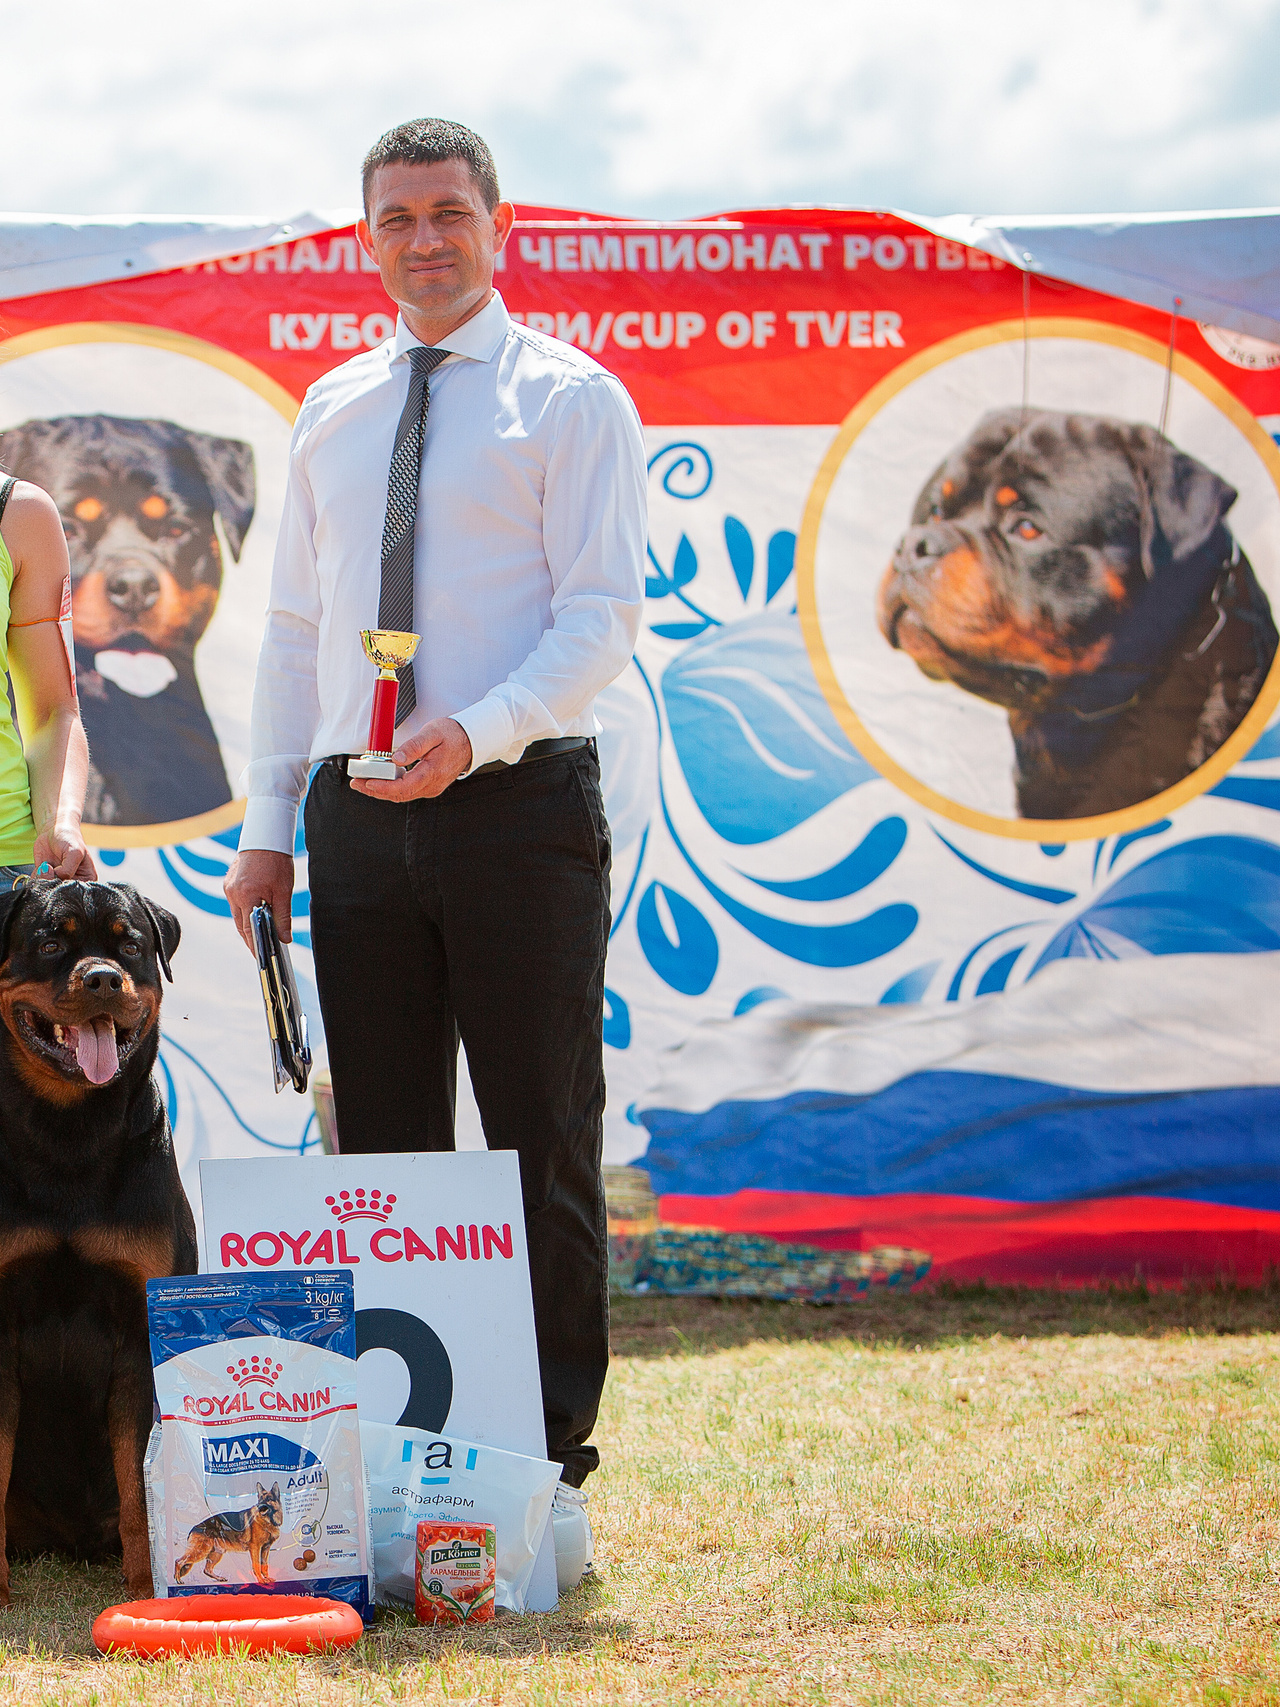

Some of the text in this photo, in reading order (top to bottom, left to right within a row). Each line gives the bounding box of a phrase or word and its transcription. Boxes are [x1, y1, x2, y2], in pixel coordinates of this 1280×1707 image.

[519, 234, 830, 272] ЧЕМПИОНАТ
[268, 312, 396, 351] КУБО
[716, 312, 777, 350] OF
[786, 311, 905, 348] TVER
[219, 1222, 515, 1268] ROYAL CANIN
[305, 1290, 345, 1307] 3 kg/кг
[183, 1386, 331, 1417] ROYAL CANIN
[207, 1438, 270, 1463] MAXI
[287, 1470, 324, 1489] Adult
[390, 1485, 475, 1508] астрафарм
[434, 1551, 447, 1562] Dr.
[448, 1549, 479, 1559] Körner
[430, 1568, 481, 1577] КАРАМЕЛЬНЫЕ
